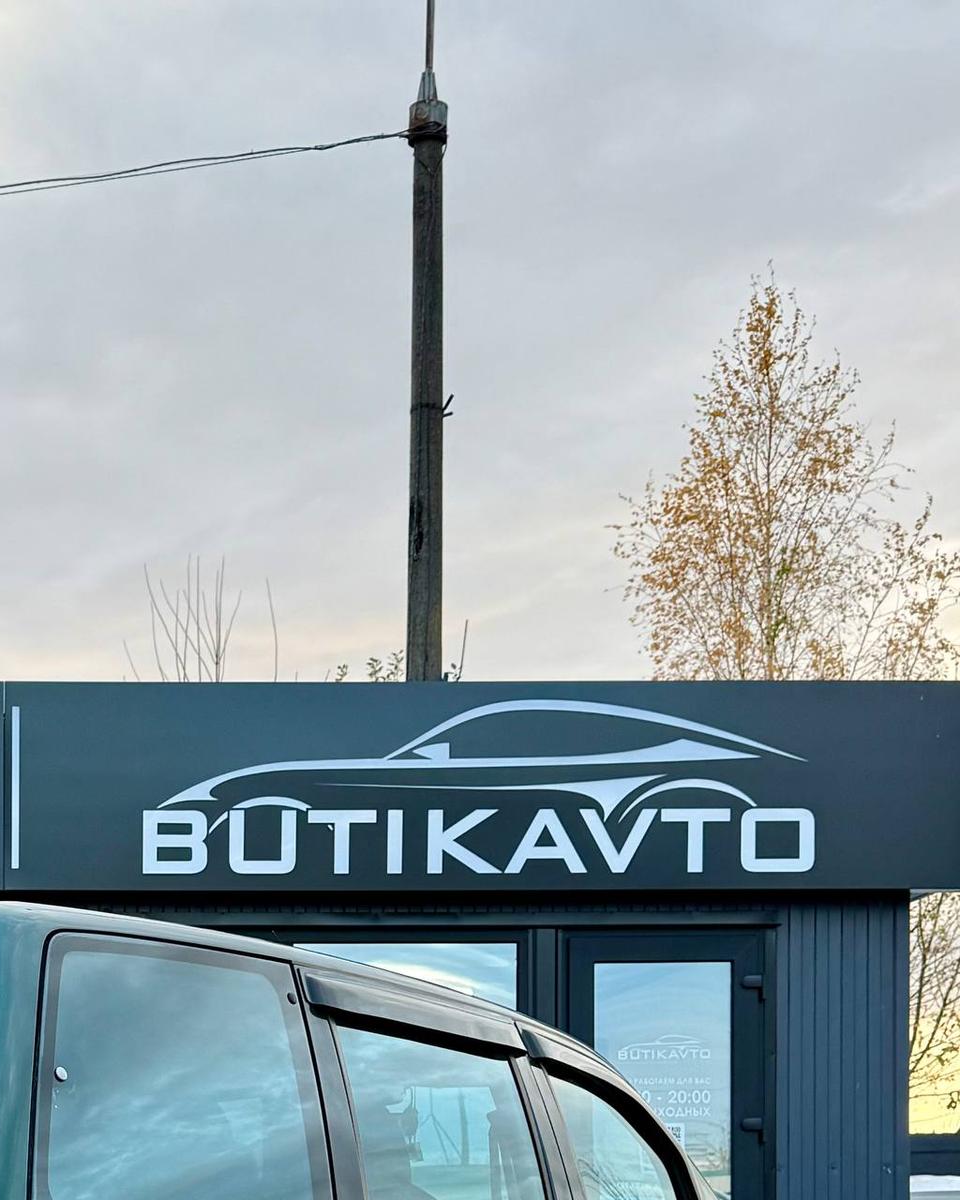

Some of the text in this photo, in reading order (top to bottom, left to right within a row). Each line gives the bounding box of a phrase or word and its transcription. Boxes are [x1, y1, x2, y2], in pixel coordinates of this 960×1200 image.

[142, 807, 816, 875] BUTIKAVTO
[618, 1048, 711, 1060] BUTIKAVTO
[668, 1090, 711, 1104] 20:00
